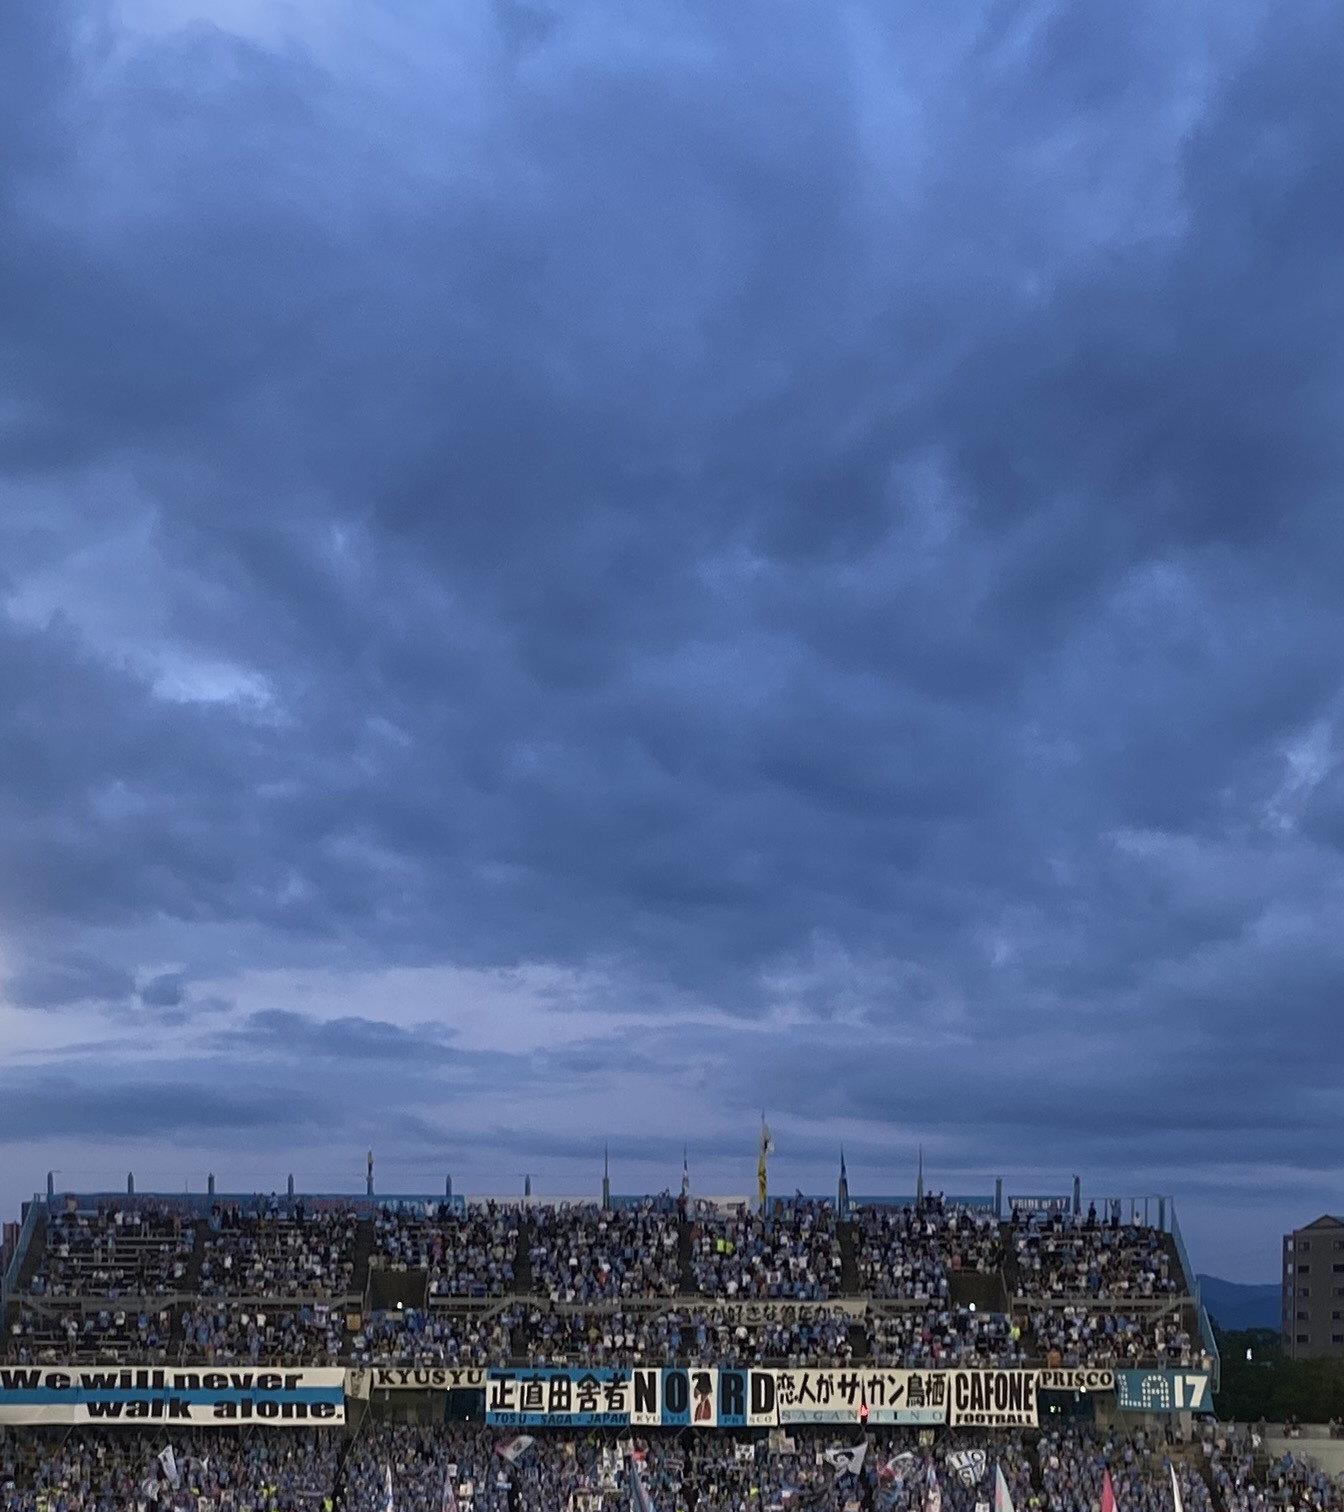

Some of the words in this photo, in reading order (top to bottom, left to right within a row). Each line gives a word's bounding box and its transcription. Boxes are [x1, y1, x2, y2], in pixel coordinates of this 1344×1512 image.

[0, 1370, 71, 1390] We
[80, 1370, 165, 1390] will
[174, 1373, 303, 1391] never
[378, 1370, 483, 1385] KYUSYU
[1042, 1372, 1112, 1386] PRISCO
[490, 1372, 628, 1412] 正直田舎者
[777, 1372, 946, 1408] 恋人がサガン鳥栖
[956, 1372, 1034, 1411] CAFONE
[87, 1398, 192, 1418] walk
[213, 1398, 343, 1418] alone.
